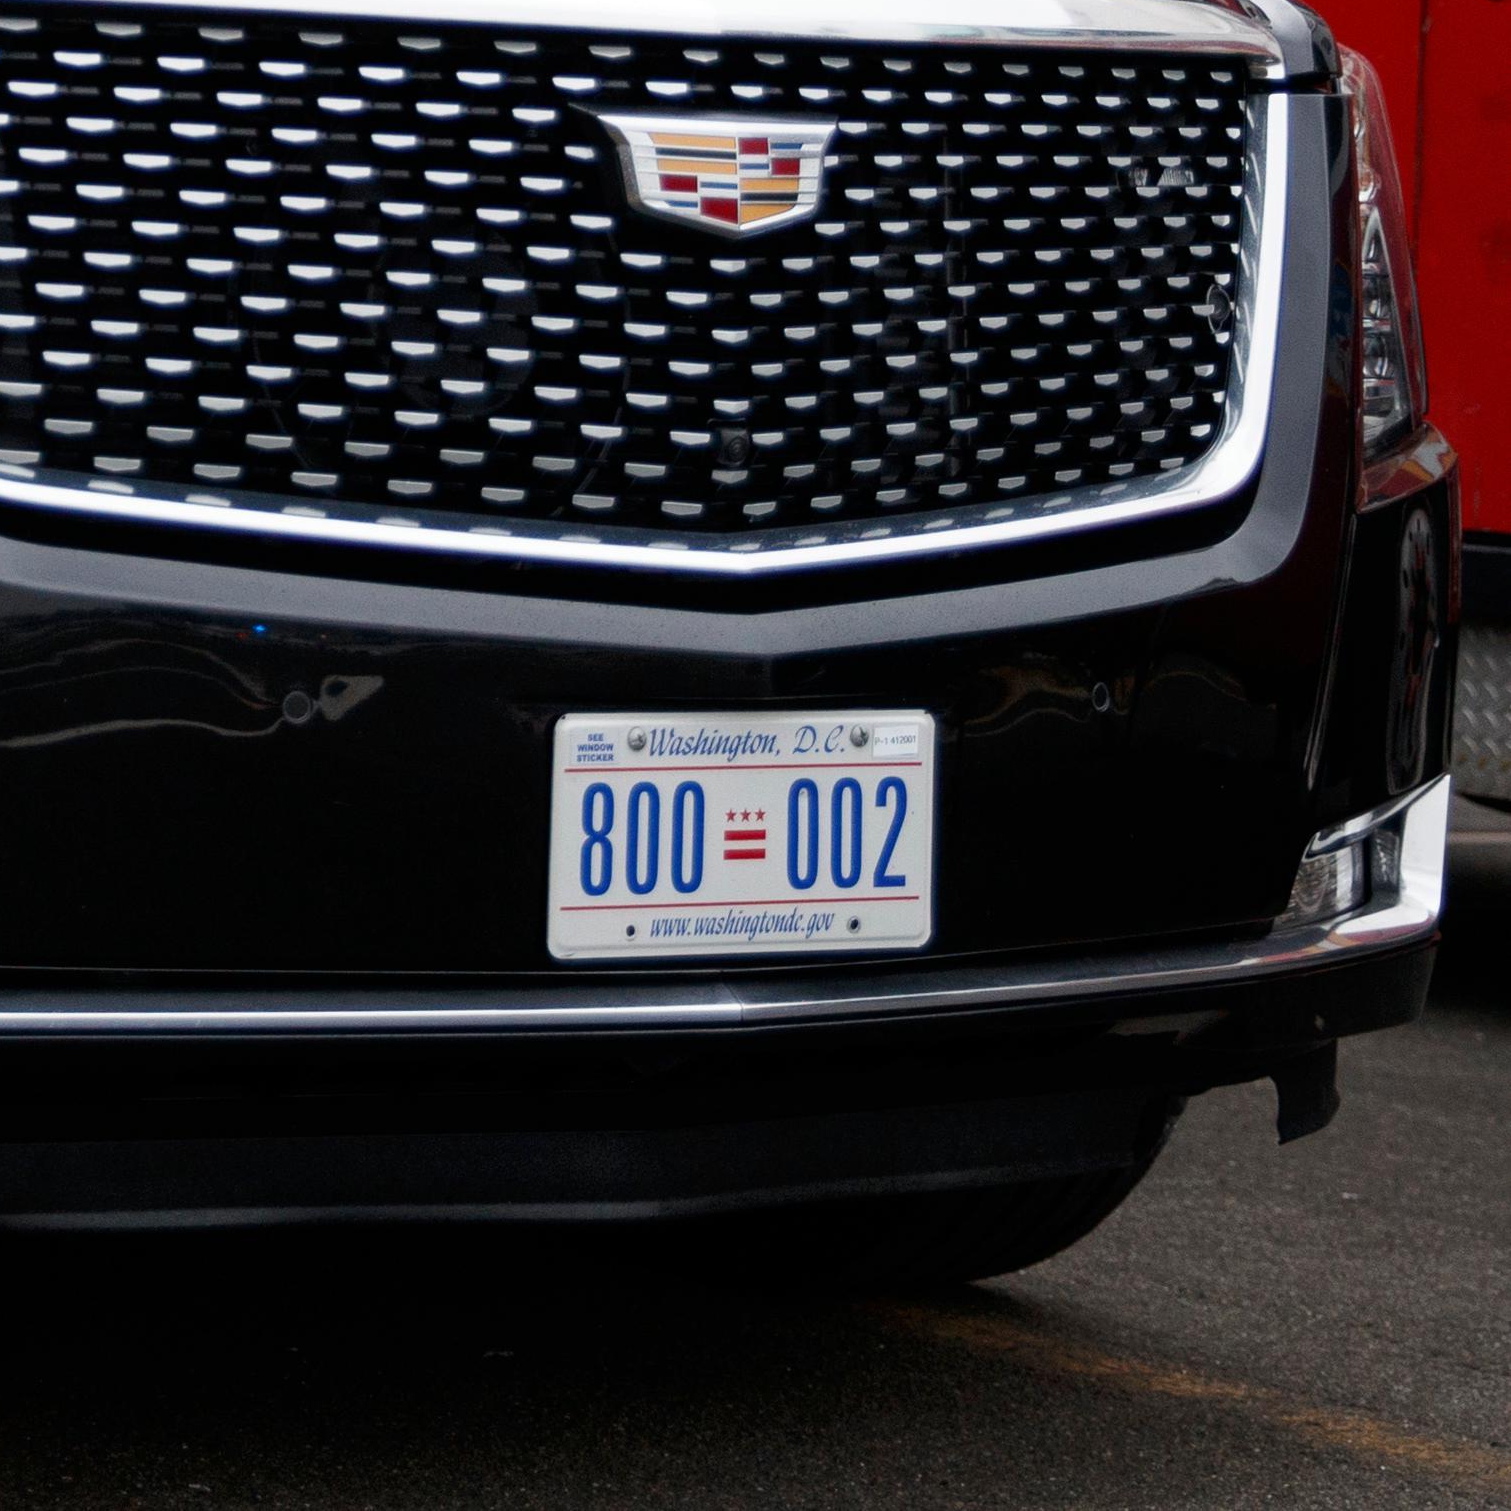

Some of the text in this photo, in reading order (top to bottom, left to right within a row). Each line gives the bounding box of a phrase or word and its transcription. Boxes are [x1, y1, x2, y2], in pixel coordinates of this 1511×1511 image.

[577, 743, 614, 752] WINDOW
[587, 733, 604, 742] SEE
[649, 725, 845, 762] Washington, D.C.
[577, 754, 614, 762] STICKER
[579, 776, 909, 897] 800 002
[649, 908, 836, 941] www.washingtondc.gov
